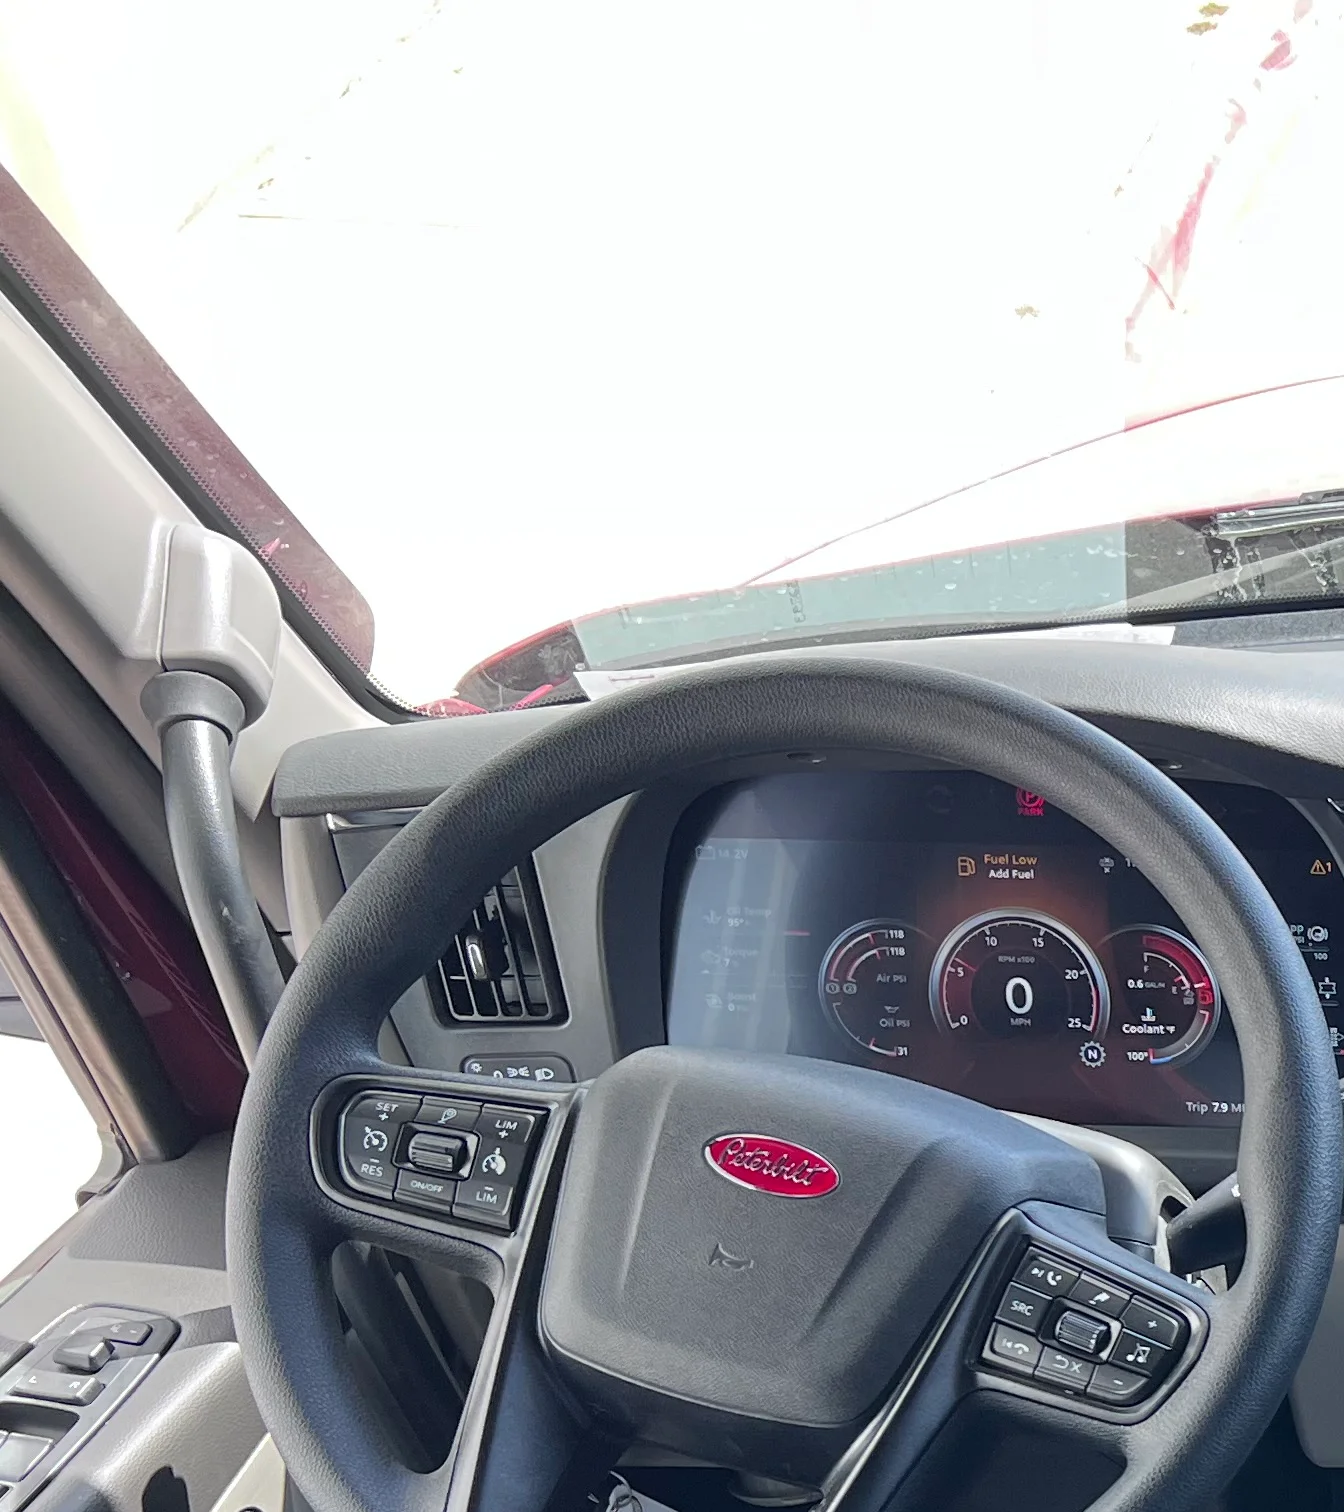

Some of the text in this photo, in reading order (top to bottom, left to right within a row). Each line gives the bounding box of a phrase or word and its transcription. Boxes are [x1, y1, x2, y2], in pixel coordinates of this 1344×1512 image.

[1017, 807, 1044, 816] PARK
[984, 854, 1038, 865] Fuel Low
[988, 869, 1034, 880] Add Fuel
[888, 930, 905, 940] 118
[985, 936, 998, 947] 10
[1032, 937, 1045, 948] 15
[889, 947, 906, 957] 118
[1313, 952, 1328, 960] 100
[998, 955, 1015, 963] RPM
[957, 966, 965, 977] 5
[1065, 969, 1079, 979] 20
[876, 973, 891, 983] Air
[1127, 979, 1144, 989] 0.6
[1005, 976, 1033, 1015] 0
[879, 1018, 895, 1028] Oil
[959, 1015, 968, 1025] 0
[1010, 1017, 1032, 1026] MPH
[1067, 1017, 1082, 1028] 25
[1121, 1023, 1165, 1034] Coolant
[897, 1046, 908, 1056] 31
[1087, 1049, 1098, 1060] N
[375, 1101, 399, 1113] SET
[1186, 1101, 1208, 1115] Trip
[1211, 1102, 1229, 1113] 7.9
[495, 1119, 518, 1131] LIM
[717, 1138, 829, 1186] Peterbilt
[360, 1163, 384, 1177] RES
[410, 1180, 444, 1193] ON/OFF
[475, 1192, 498, 1204] LIM
[1010, 1300, 1034, 1316] SRC
